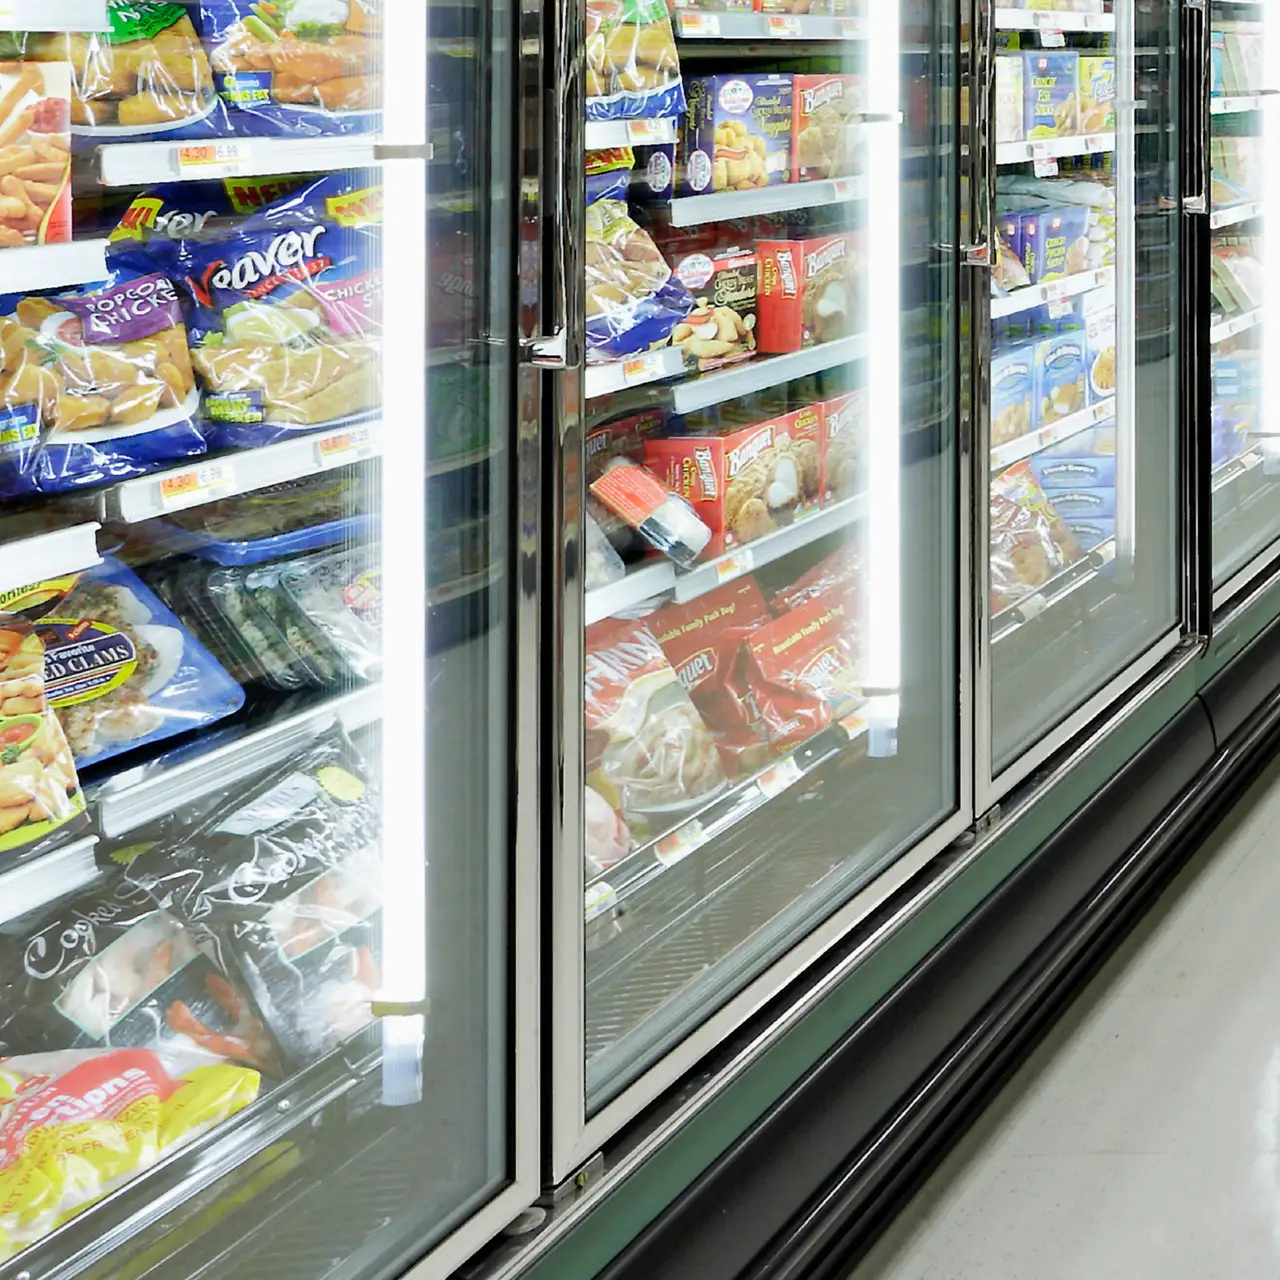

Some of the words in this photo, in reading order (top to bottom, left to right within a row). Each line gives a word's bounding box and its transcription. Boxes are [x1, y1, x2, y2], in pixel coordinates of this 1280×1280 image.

[697, 447, 718, 498] Banquet
[51, 642, 96, 661] Favorite
[67, 644, 130, 674] CLAMS
